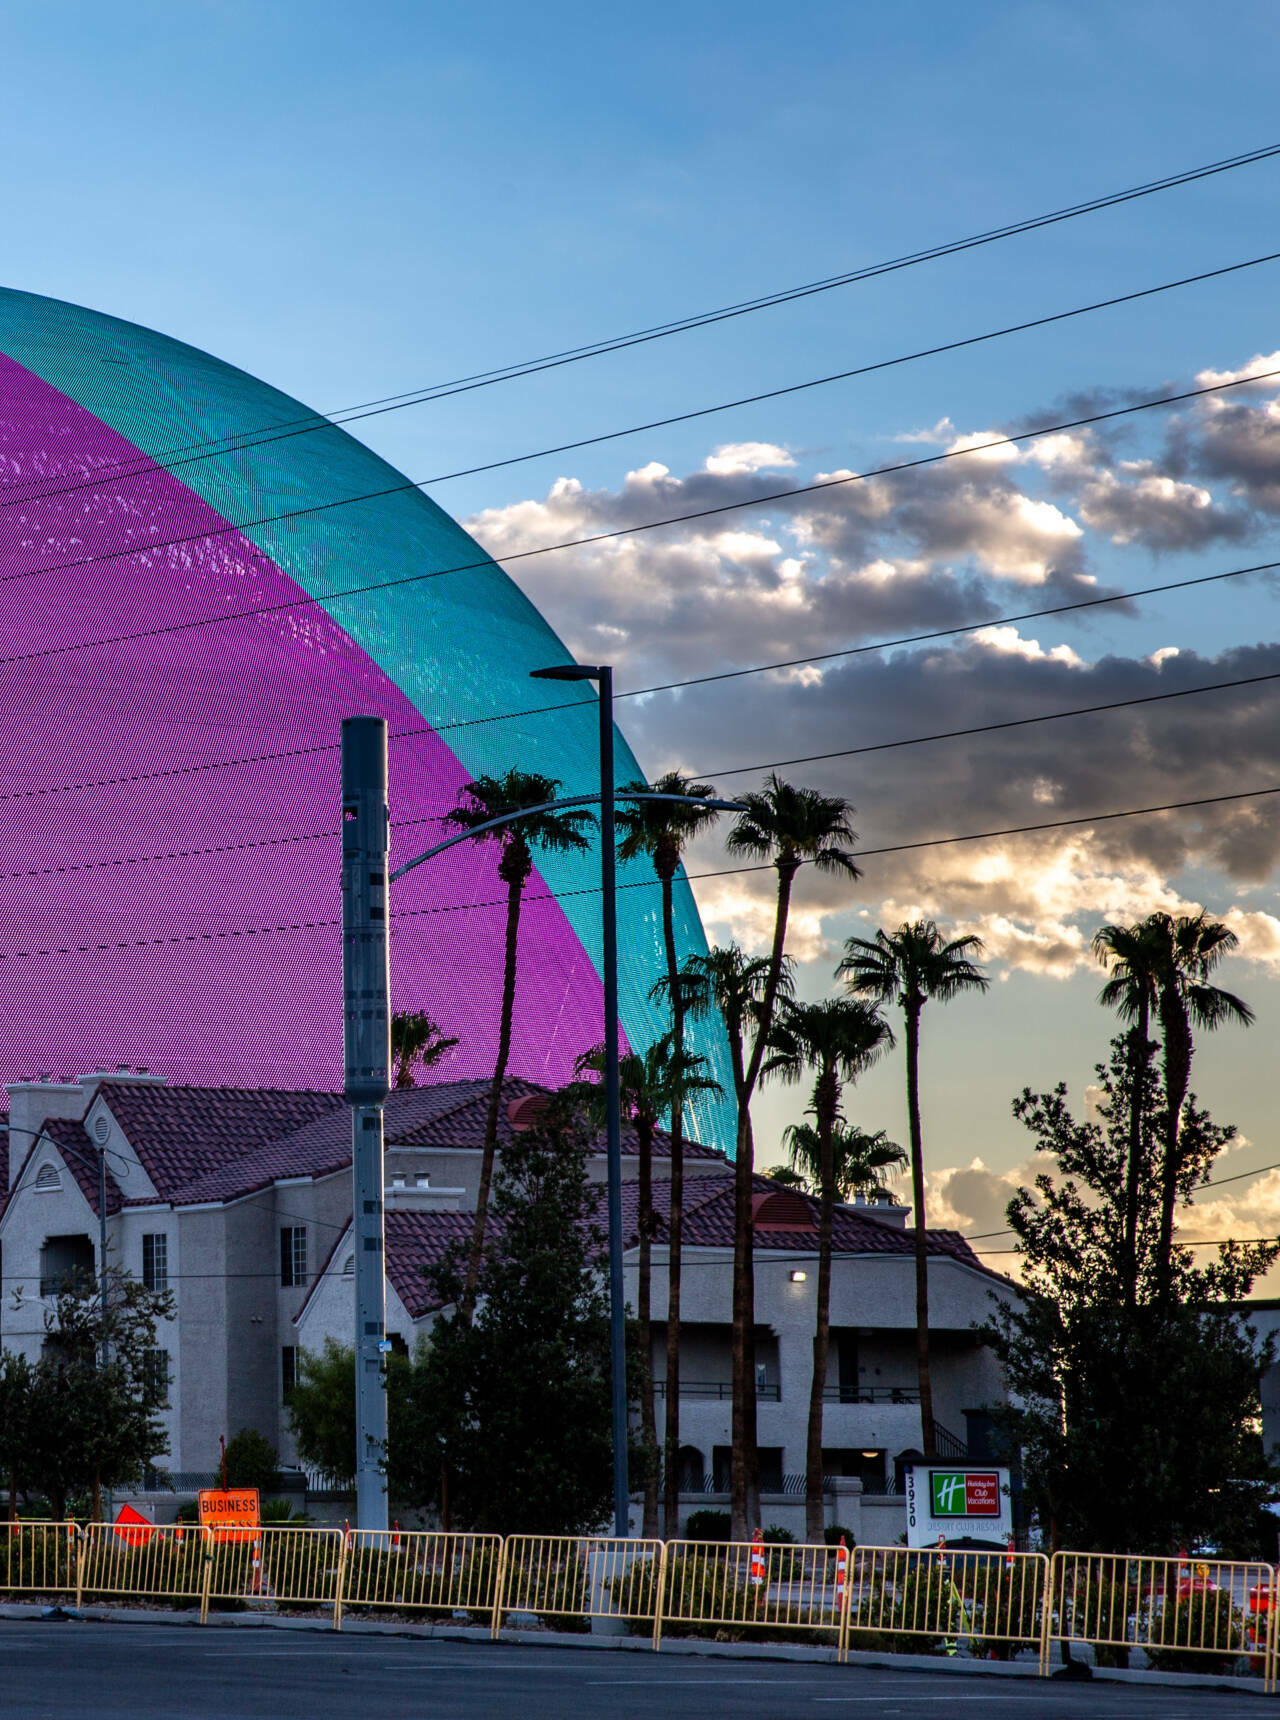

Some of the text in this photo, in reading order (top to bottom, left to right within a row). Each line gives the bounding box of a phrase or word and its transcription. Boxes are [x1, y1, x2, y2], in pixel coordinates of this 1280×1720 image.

[967, 1480, 987, 1489] Holiday
[974, 1488, 988, 1497] Club
[908, 1476, 916, 1527] 3950
[967, 1496, 996, 1505] Vacations
[202, 1499, 256, 1513] BUSINESS
